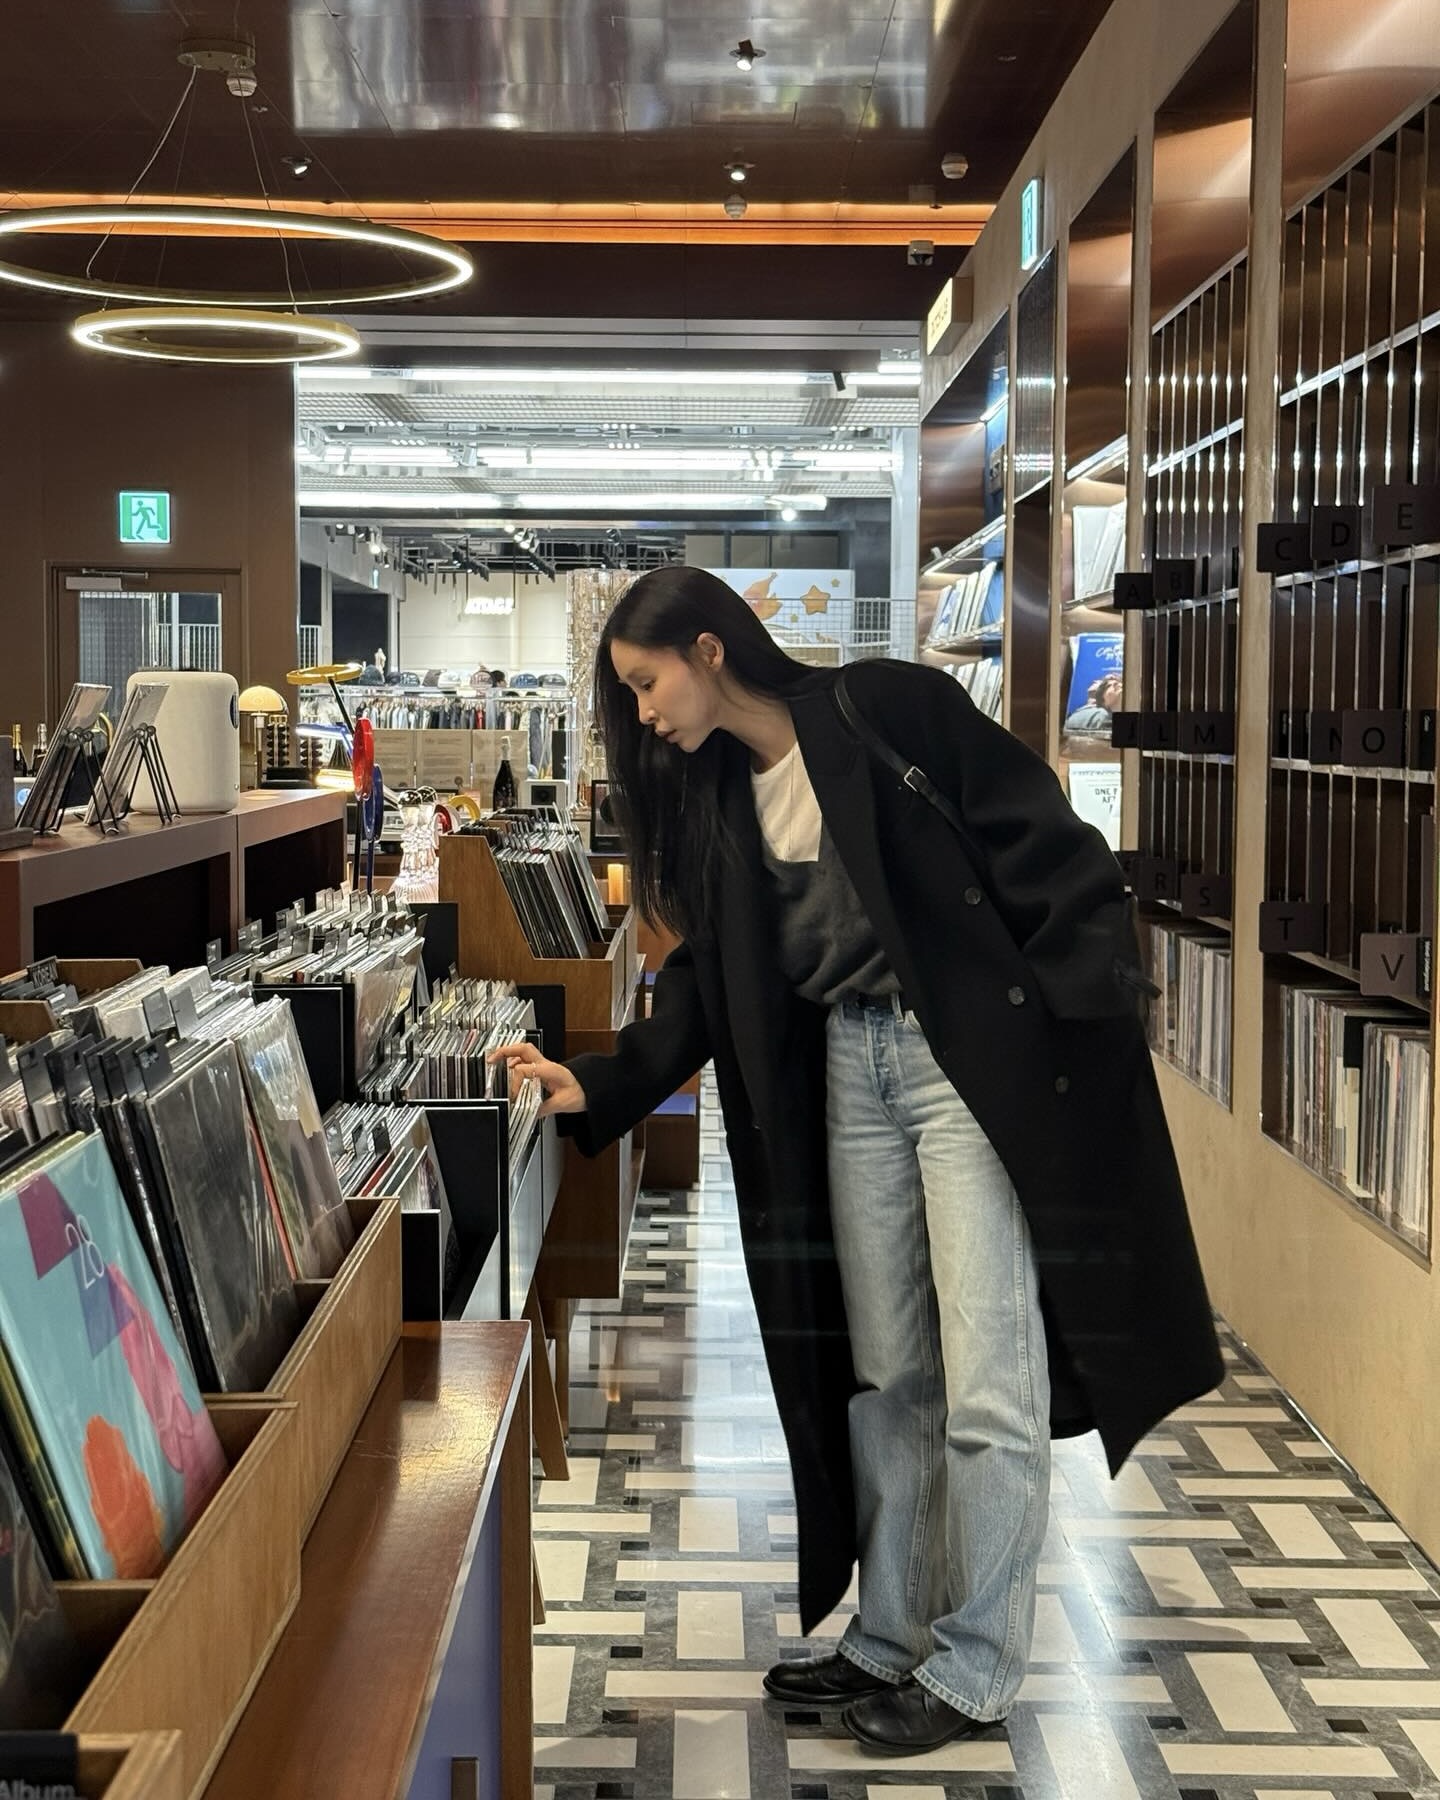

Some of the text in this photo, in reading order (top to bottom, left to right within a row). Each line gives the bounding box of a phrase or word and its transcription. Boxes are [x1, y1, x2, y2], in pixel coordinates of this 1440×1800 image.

[1397, 502, 1413, 530] E
[1331, 522, 1350, 546] D
[1275, 537, 1292, 561] C
[1126, 583, 1141, 601] A
[1159, 722, 1169, 742] L
[1194, 723, 1216, 745] M
[1362, 727, 1385, 754] O
[1155, 872, 1167, 891] R
[1199, 886, 1211, 907] S
[1277, 918, 1294, 941] T
[1380, 953, 1405, 982] V
[65, 1214, 105, 1290] 28
[0, 1778, 76, 1800] Album
